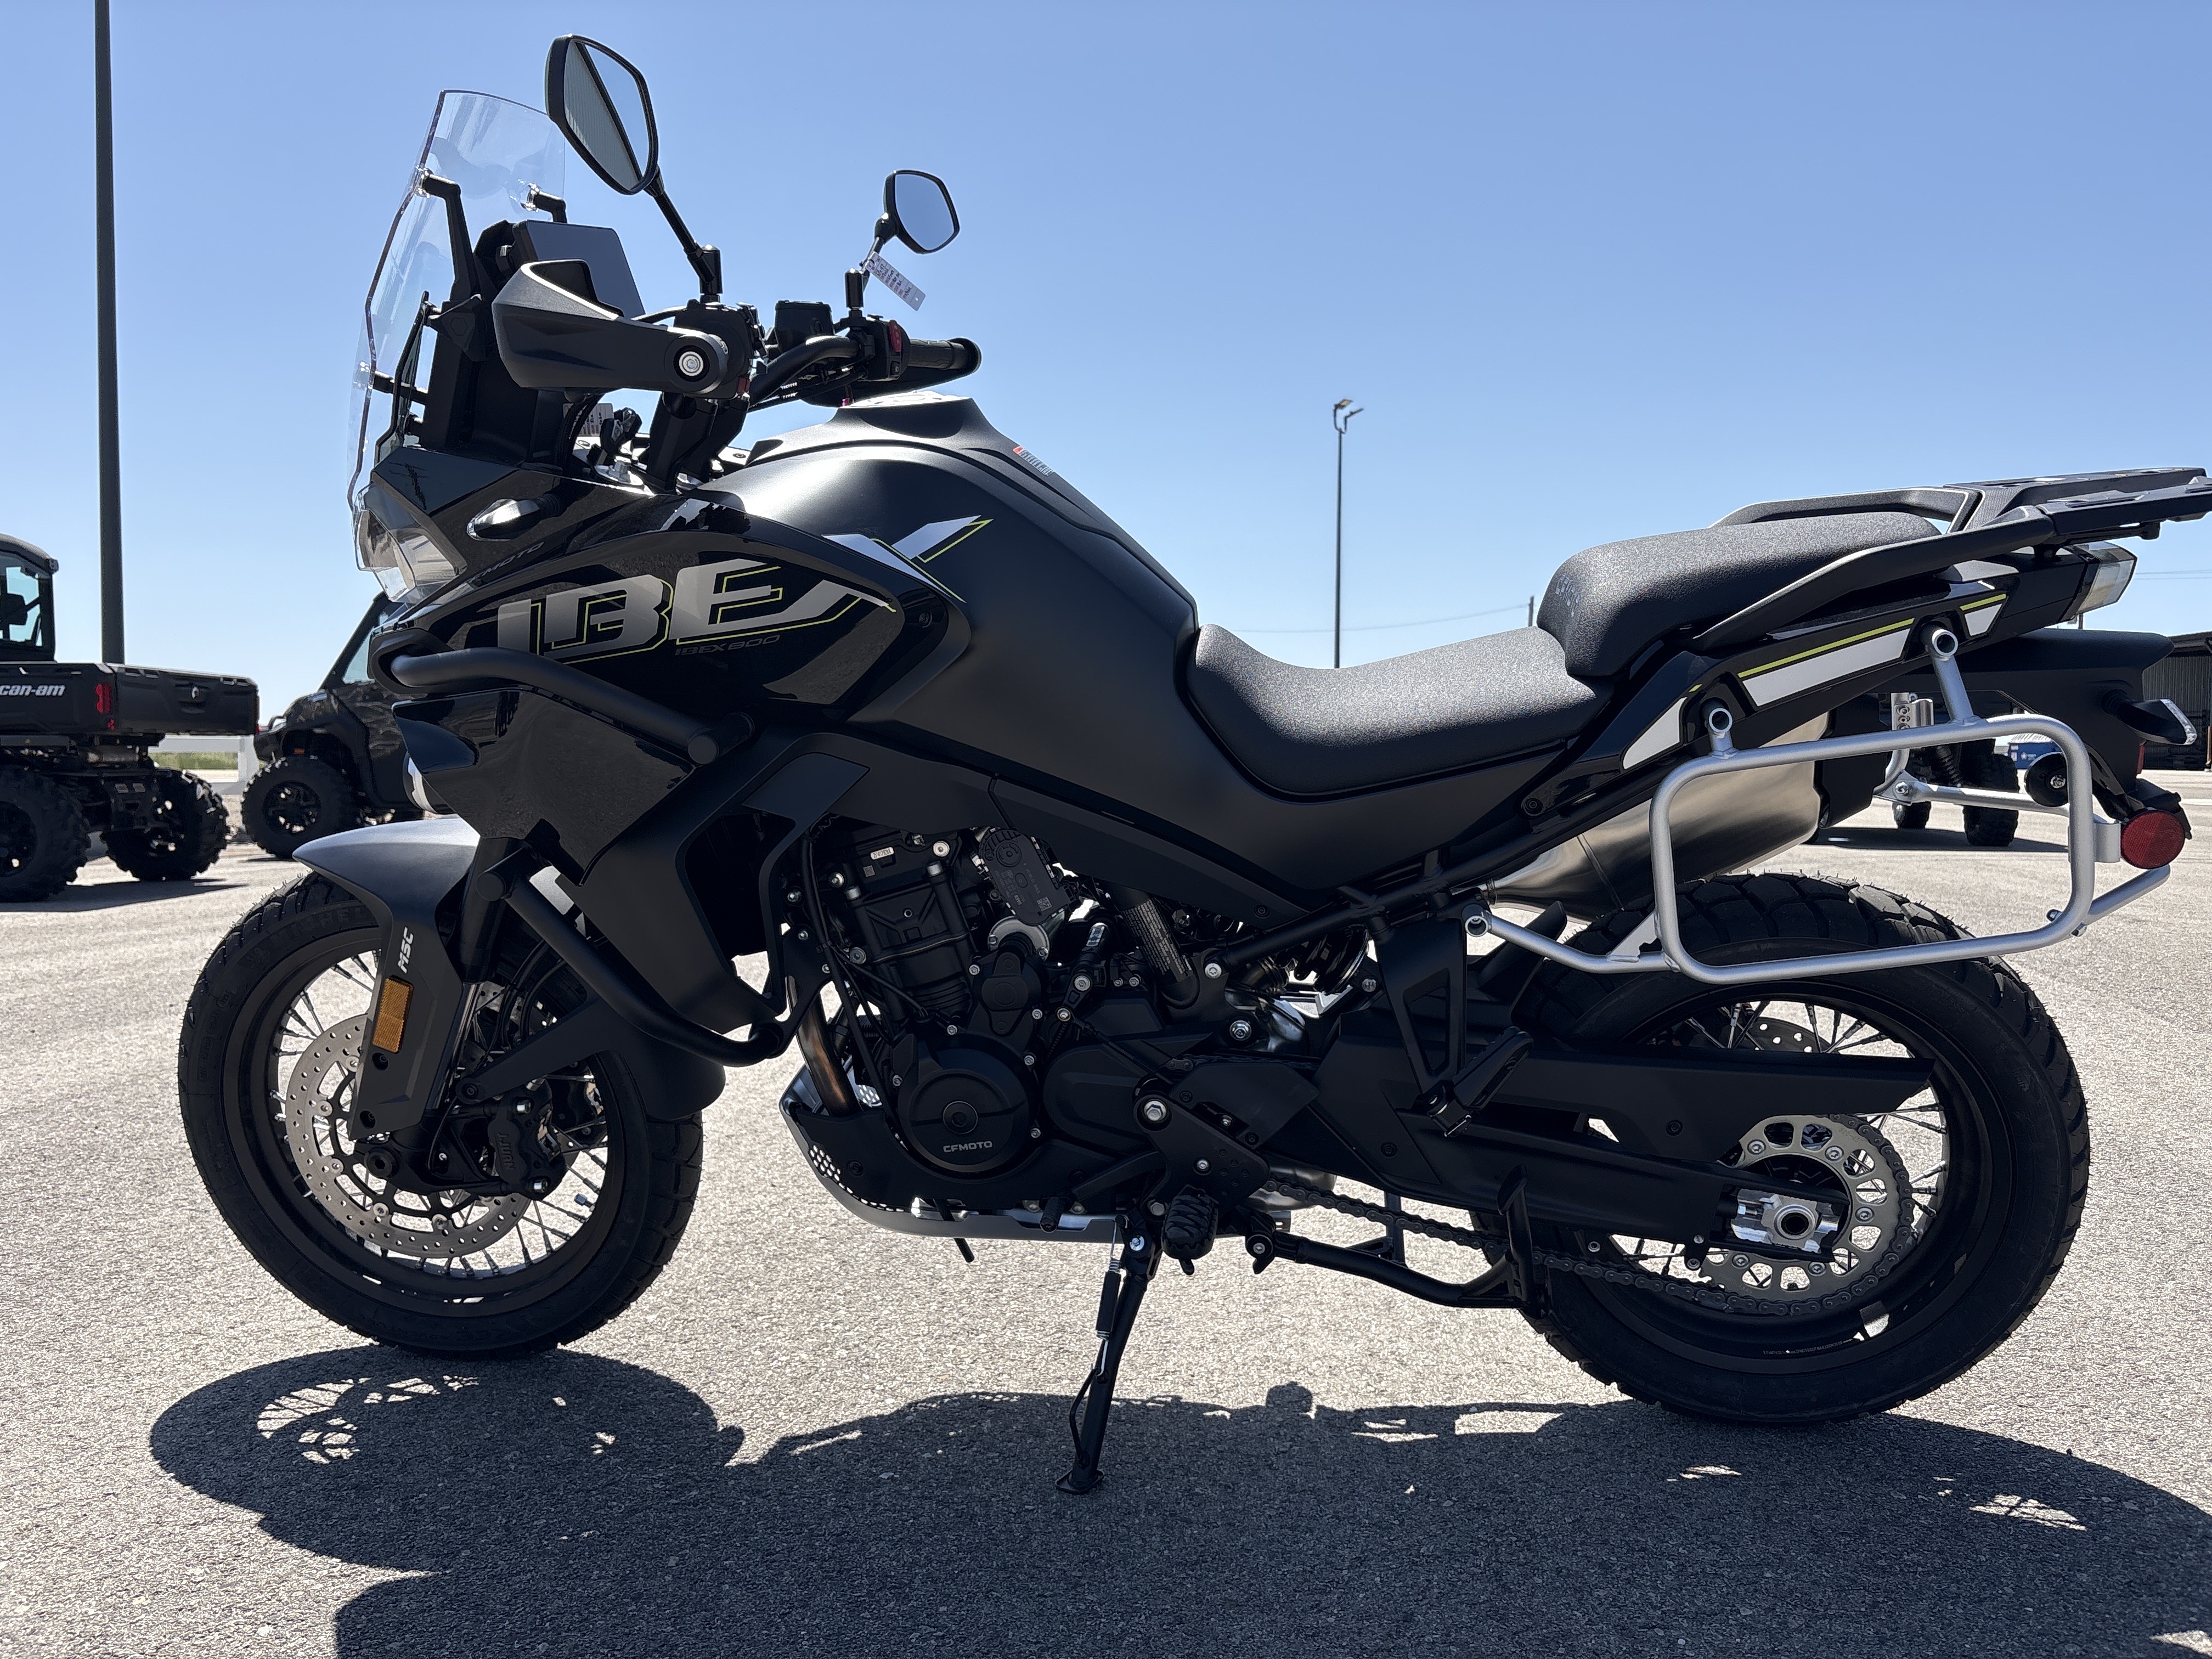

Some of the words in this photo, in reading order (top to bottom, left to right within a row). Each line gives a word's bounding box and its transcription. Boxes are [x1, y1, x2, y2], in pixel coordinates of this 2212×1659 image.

[675, 643, 728, 656] IBEX
[727, 634, 781, 651] 800
[0, 685, 66, 696] can-am
[398, 926, 414, 974] MSC
[943, 1141, 993, 1153] CFMOTO
